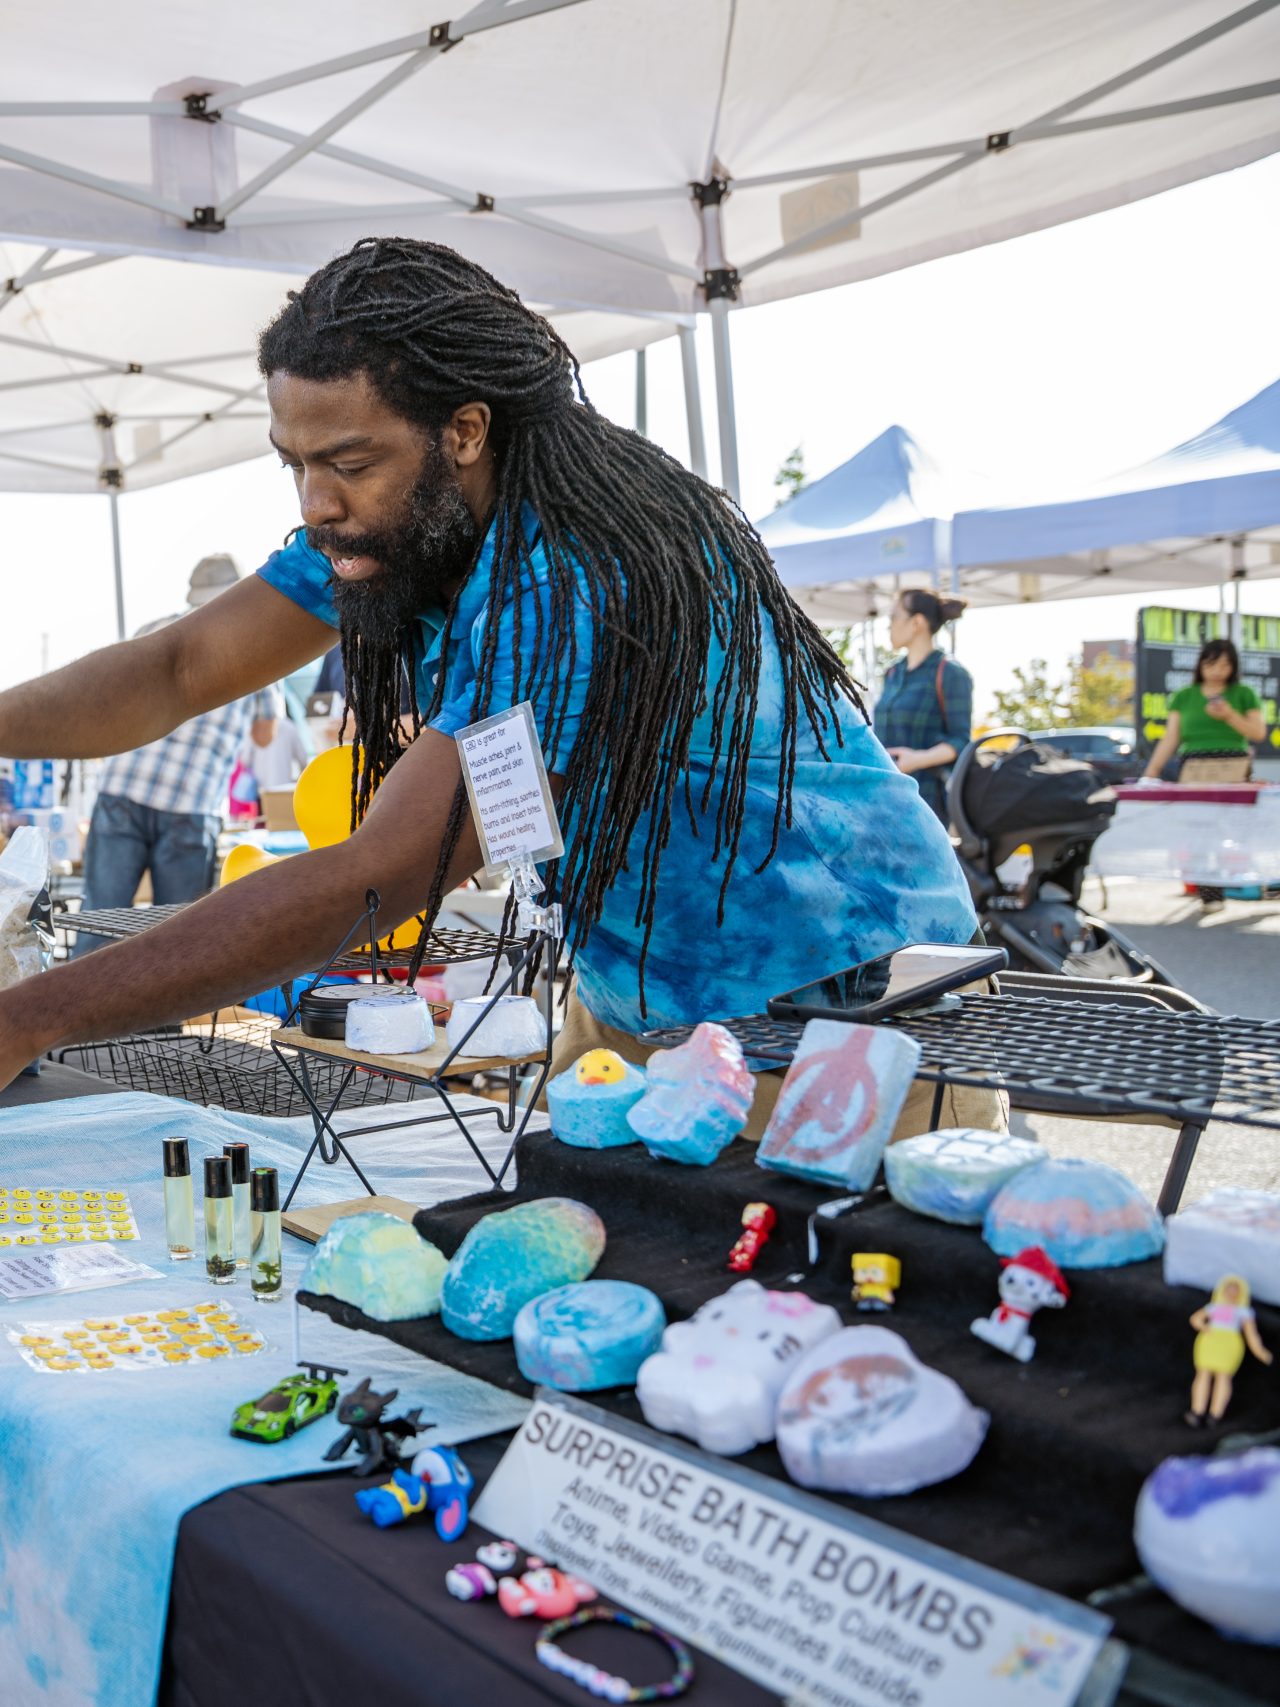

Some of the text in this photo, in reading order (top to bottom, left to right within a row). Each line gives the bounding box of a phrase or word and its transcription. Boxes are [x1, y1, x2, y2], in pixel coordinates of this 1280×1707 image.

[465, 728, 506, 751] CBD is great for
[469, 757, 488, 769] Muscle
[504, 744, 516, 760] joint
[472, 773, 488, 783] nerve
[501, 761, 512, 773] and
[512, 758, 524, 768] skin
[519, 789, 540, 803] soothes
[483, 819, 500, 830] burns
[500, 815, 511, 825] and
[511, 809, 527, 821] insect
[487, 822, 537, 844] Has wound healing
[525, 1409, 995, 1652] SURPRISE BATH BOMBS
[551, 1501, 600, 1550] Toys,
[603, 1529, 708, 1605] Jewellery,
[714, 1585, 829, 1664] Figurines
[563, 1475, 946, 1679] Anime, Video Game, Pop Culture
